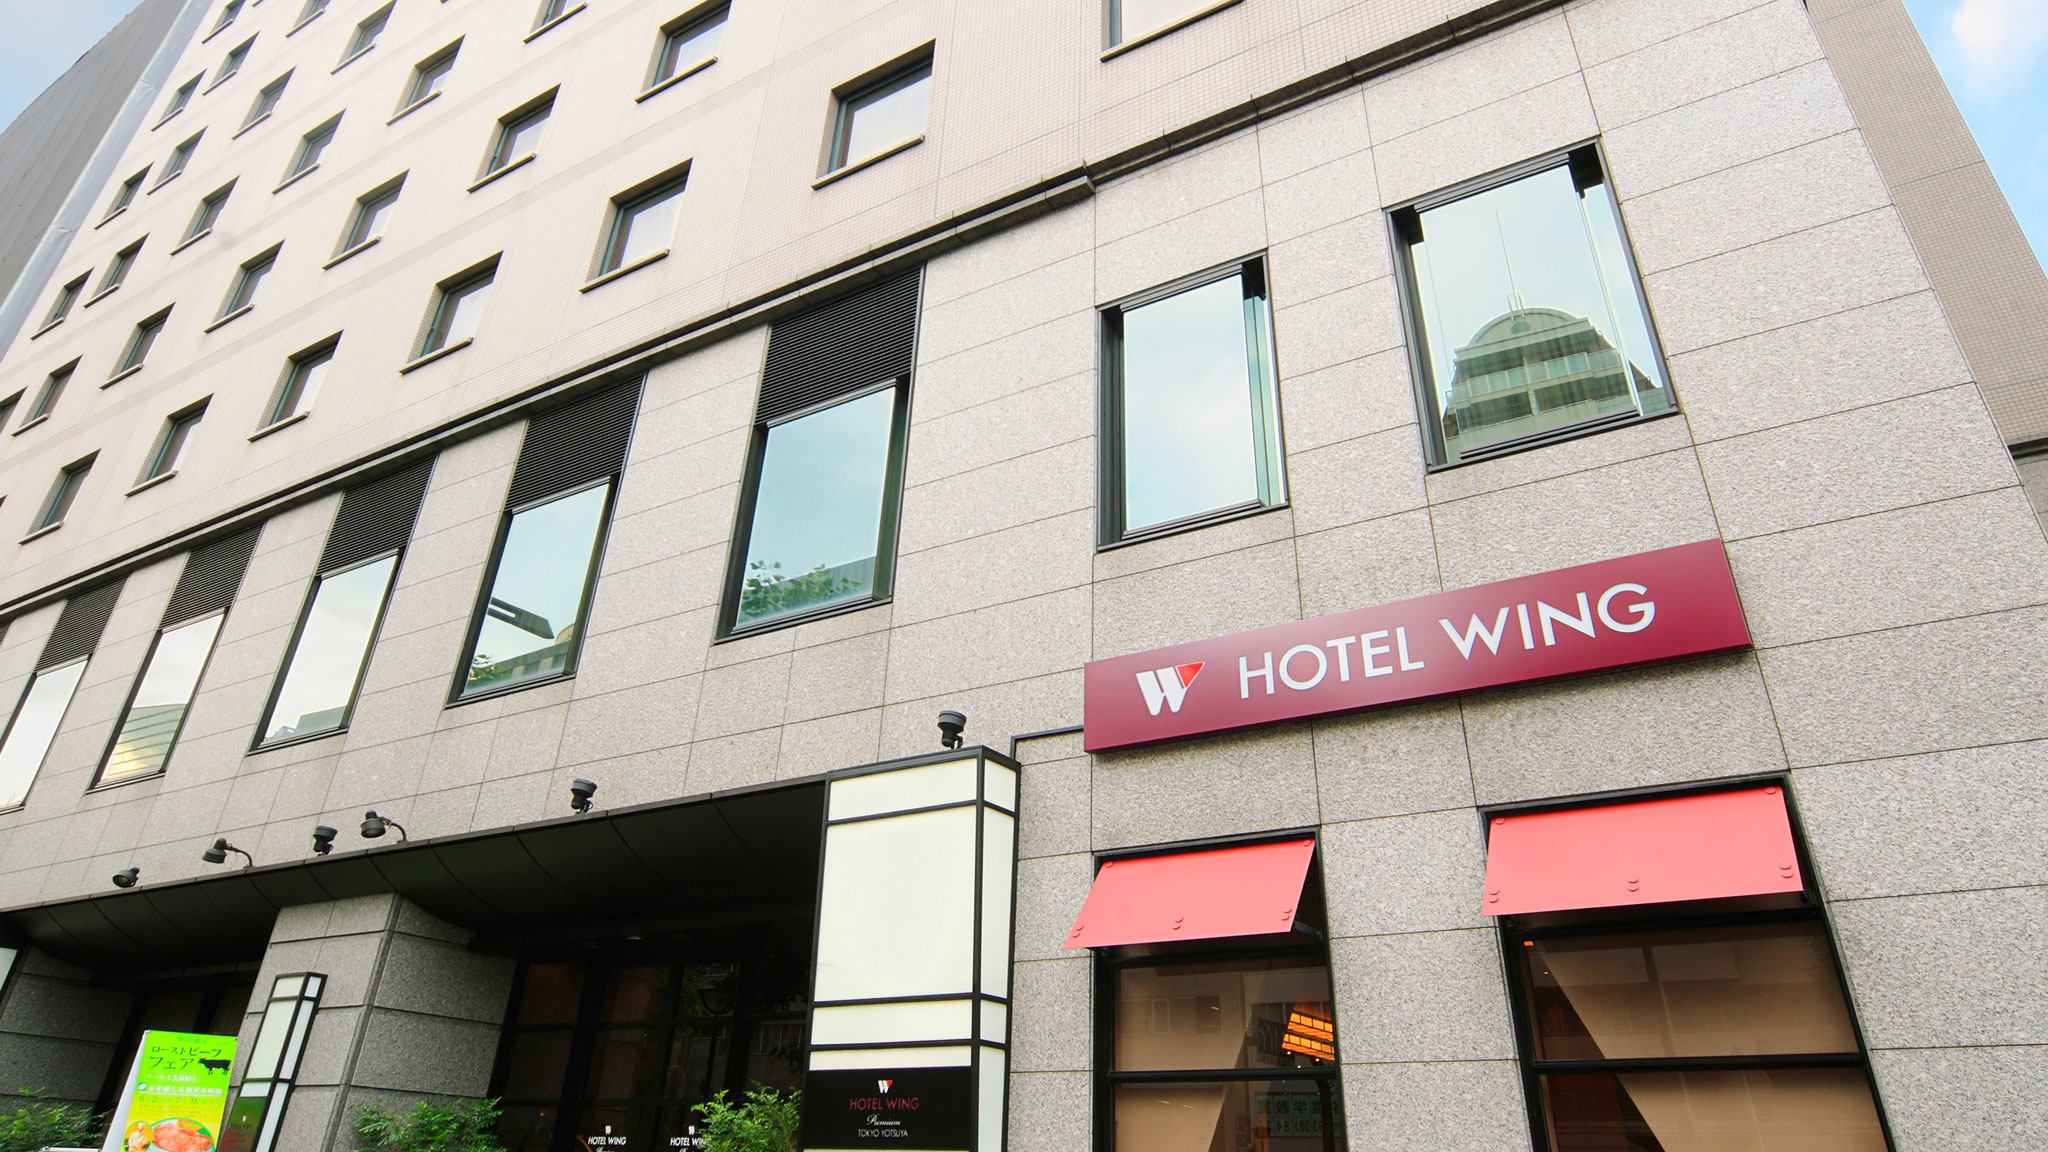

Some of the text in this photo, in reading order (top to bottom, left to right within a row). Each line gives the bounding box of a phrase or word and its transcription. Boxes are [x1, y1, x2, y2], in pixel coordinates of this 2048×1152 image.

[1238, 582, 1656, 699] HOTEL WING
[152, 1045, 222, 1058] ローストビーフ
[149, 1056, 194, 1070] フェア
[849, 1096, 920, 1111] HOTEL WING
[865, 1113, 901, 1126] Premium
[858, 1129, 909, 1138] TOKYO YOTSUYA
[587, 1136, 627, 1146] HOTEL WING
[669, 1137, 690, 1147] HOTEL
